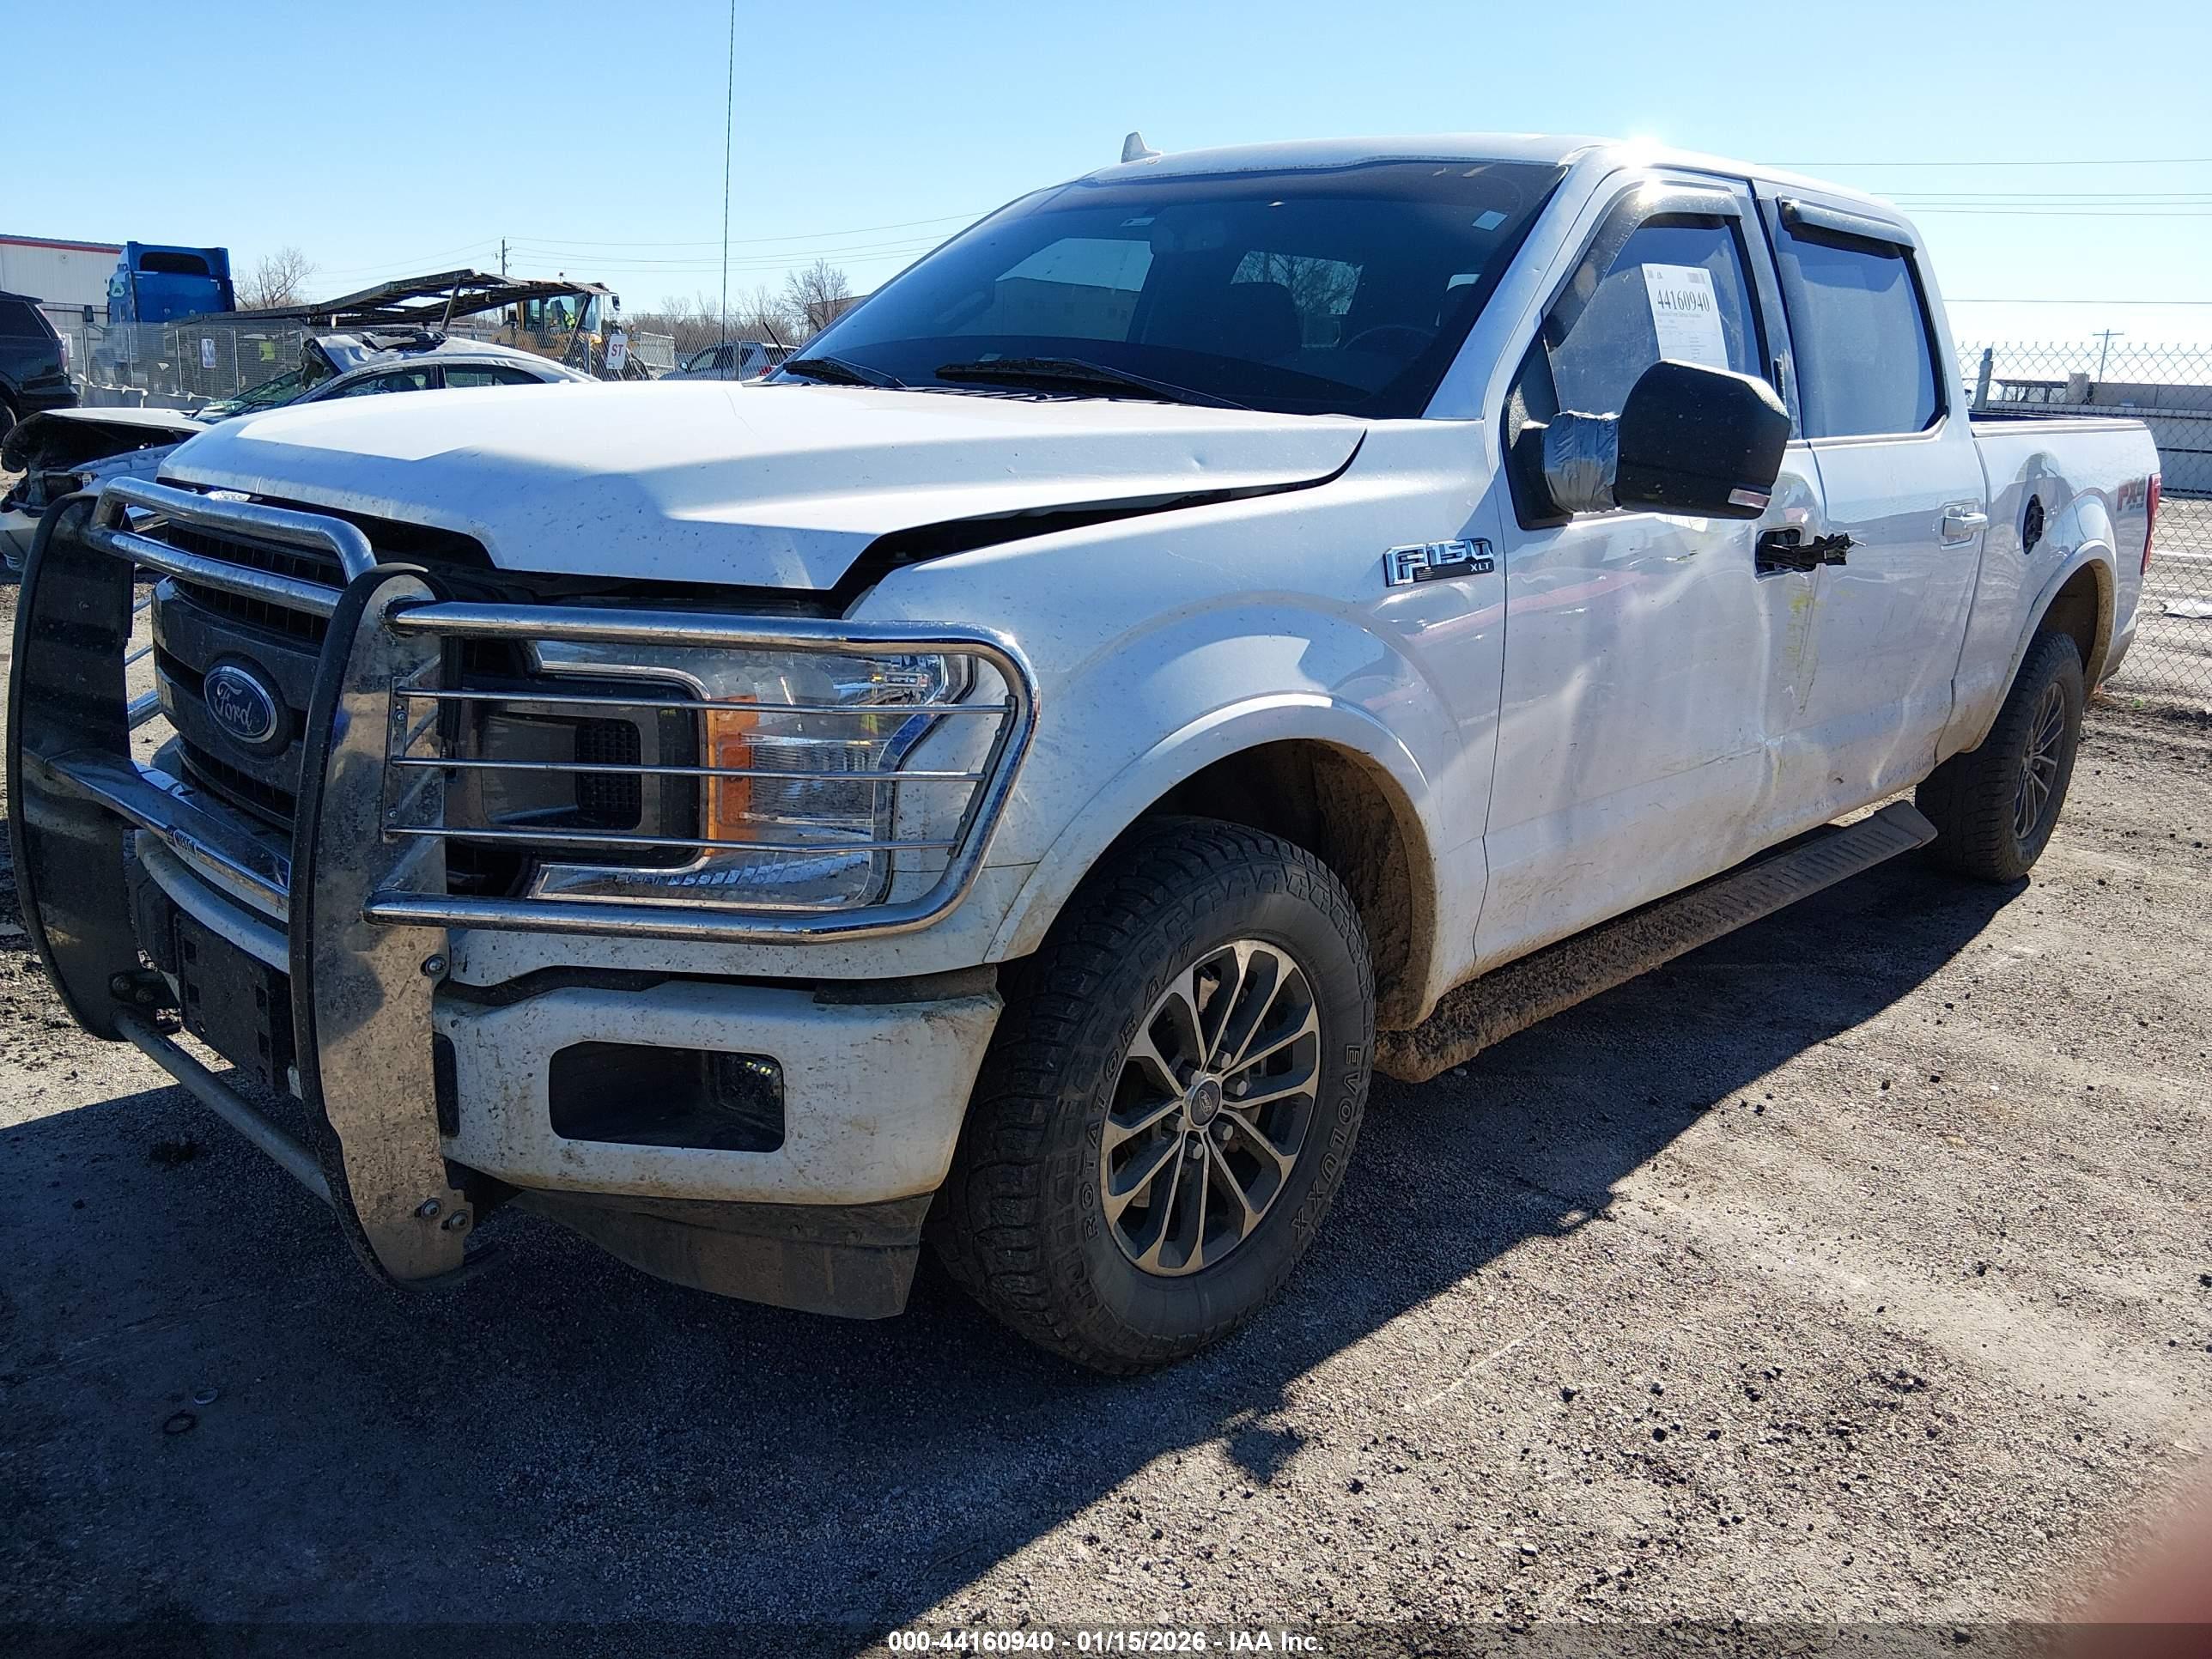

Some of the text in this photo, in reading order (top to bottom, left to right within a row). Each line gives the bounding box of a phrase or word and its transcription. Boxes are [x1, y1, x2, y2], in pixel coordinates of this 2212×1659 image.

[1656, 289, 1711, 312] 44160940
[611, 343, 624, 357] ST
[1470, 561, 1491, 572] XLT
[214, 681, 252, 730] Ford
[1079, 937, 1197, 1239] ROTATOR A/T
[1291, 1043, 1361, 1238] EVOLUXX
